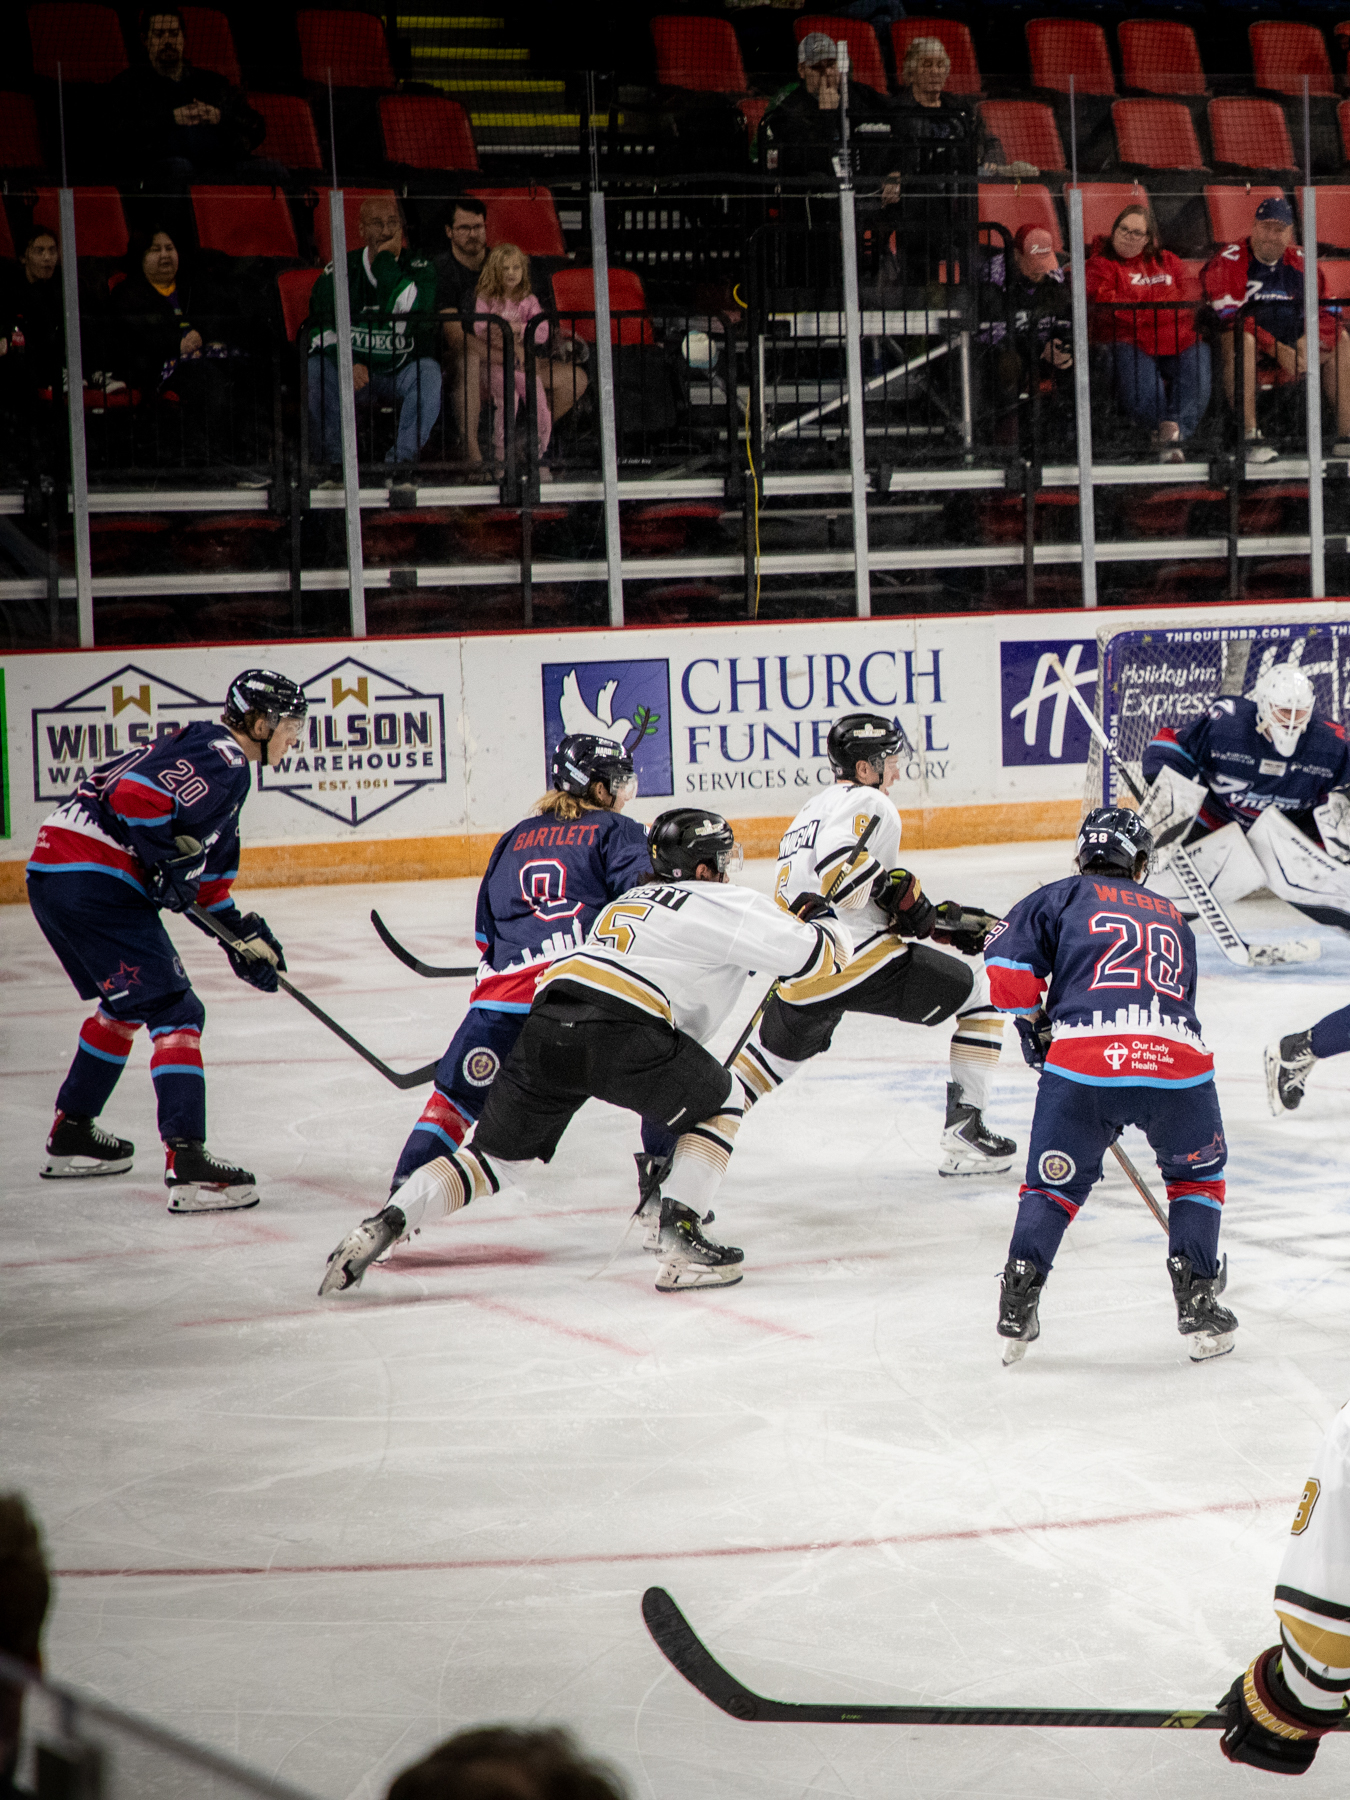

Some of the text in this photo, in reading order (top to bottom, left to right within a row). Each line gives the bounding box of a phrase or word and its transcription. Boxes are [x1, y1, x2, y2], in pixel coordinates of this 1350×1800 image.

[350, 332, 406, 350] YDECO
[1166, 627, 1291, 644] THEQUEENBR.COM
[681, 648, 947, 715] CHURCH
[1122, 663, 1187, 687] Holiday
[46, 719, 184, 763] WILS
[295, 711, 432, 753] ILSON
[684, 713, 950, 765] FUNEAL
[272, 751, 434, 774] WAREHOUSE
[158, 759, 209, 806] 20
[318, 778, 389, 792] EST. 1961
[686, 767, 787, 793] SERVICES
[794, 767, 810, 787] &
[513, 824, 599, 851] BARTLETT
[1089, 832, 1108, 844] 28
[1093, 882, 1184, 927] WEBER
[1174, 850, 1239, 951] WARRIOR
[593, 901, 655, 955] 5
[1088, 910, 1184, 1001] 28
[1131, 1040, 1169, 1055] Our Lady
[1131, 1050, 1175, 1064] of the Lake
[1131, 1060, 1158, 1071] Health
